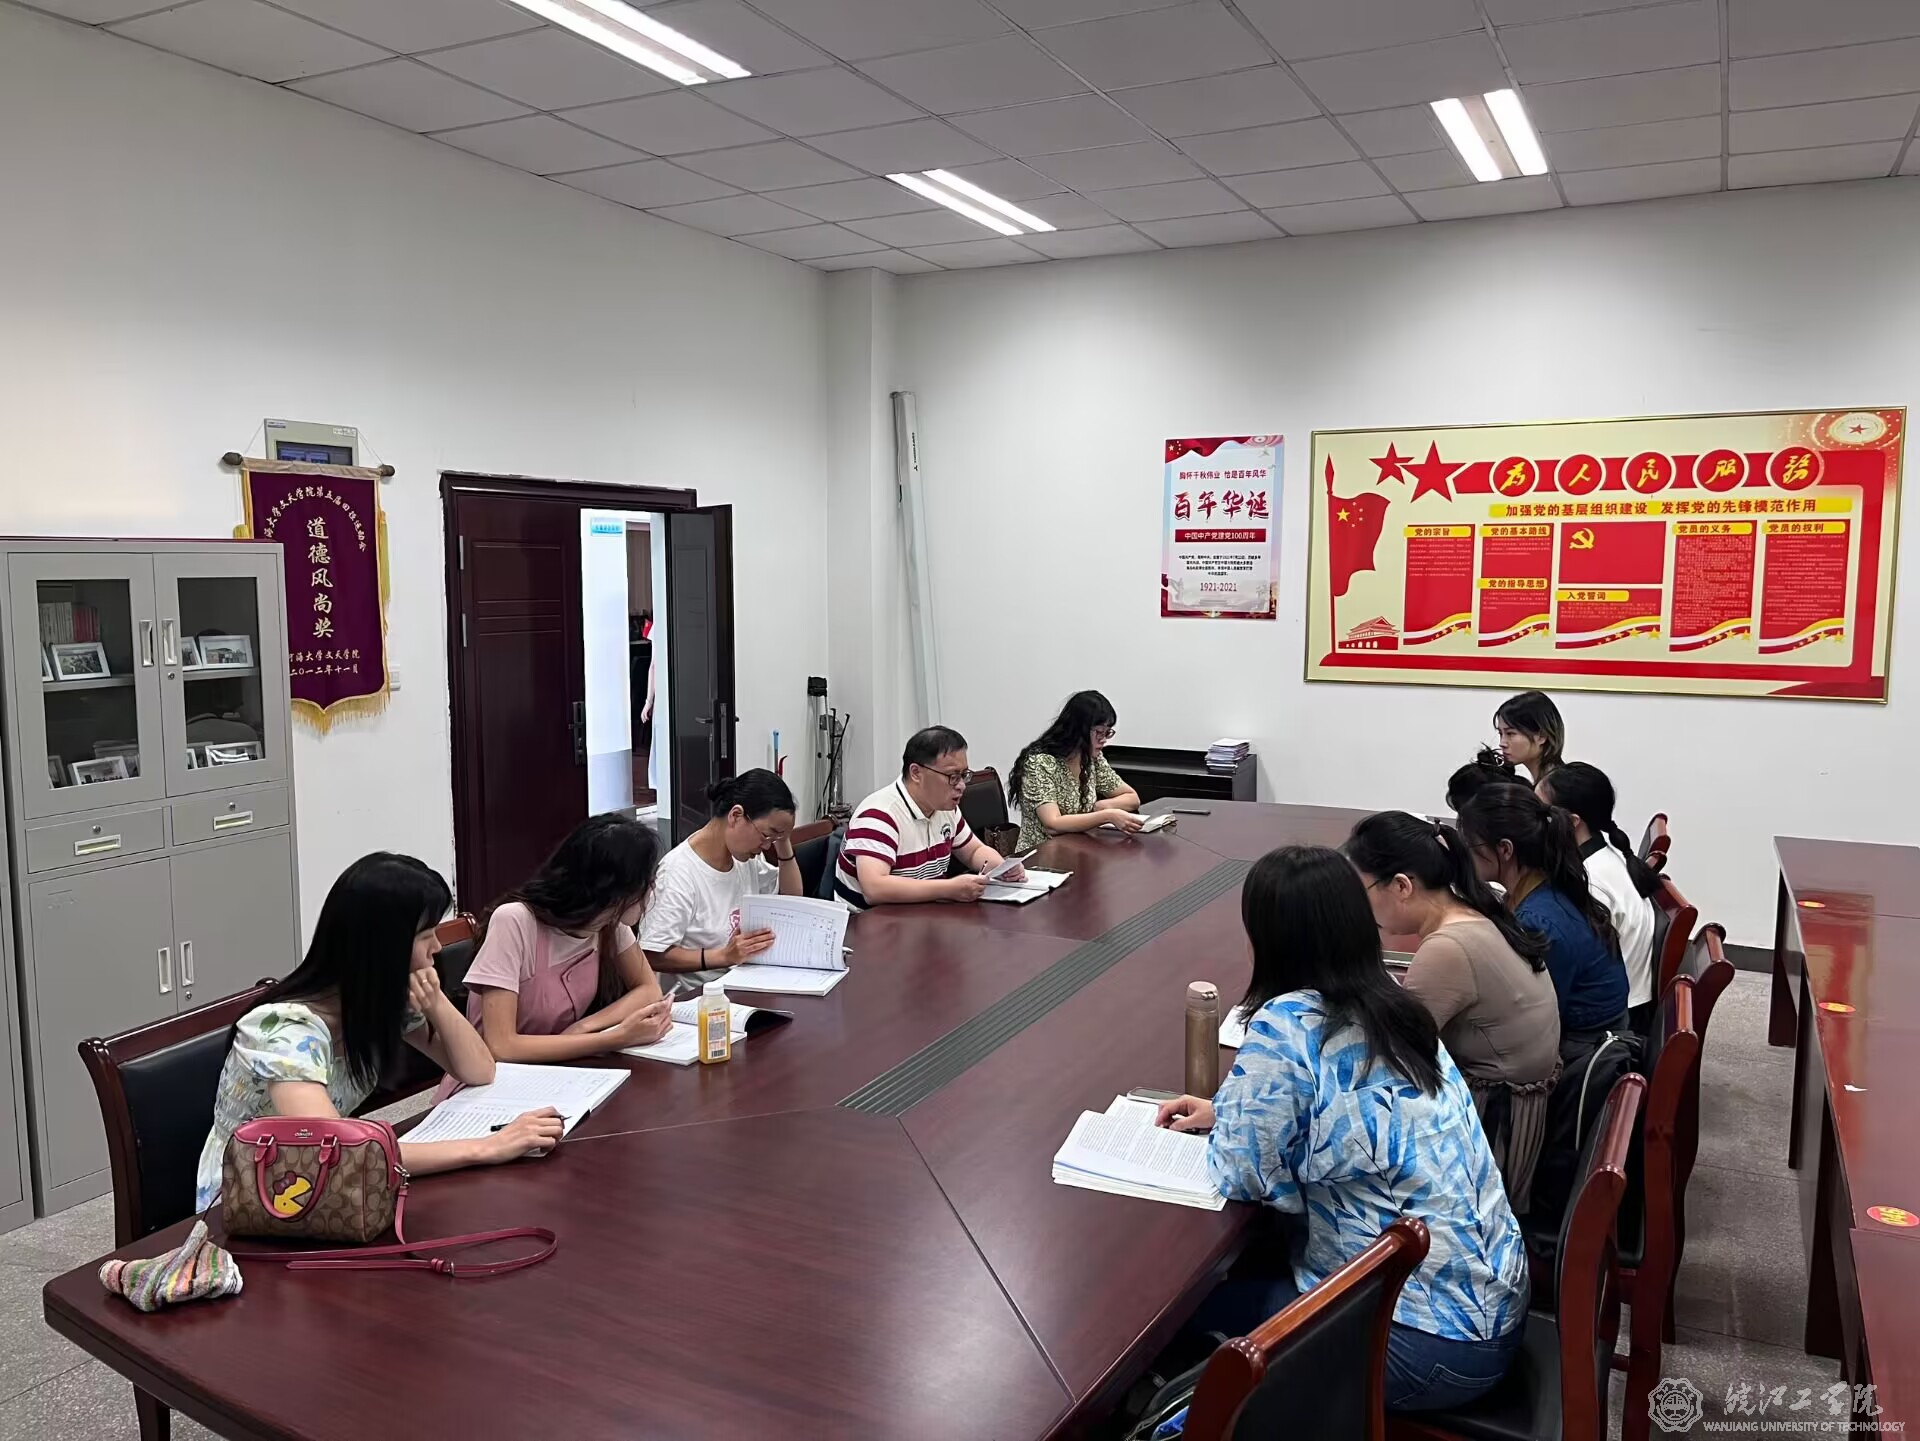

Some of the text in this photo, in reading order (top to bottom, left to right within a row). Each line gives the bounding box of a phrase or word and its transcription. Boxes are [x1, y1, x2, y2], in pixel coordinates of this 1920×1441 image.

[1224, 469, 1267, 479] 恰是百年风华
[1174, 489, 1269, 521] 百年华诞
[1505, 499, 1817, 517] 加强党的基层组织建设 发挥党的先锋模范作用
[1414, 527, 1450, 536] 党的宗旨
[1491, 526, 1547, 536] 党的基本路线
[1678, 523, 1732, 533] 党员的义务
[1769, 523, 1824, 532] 党员的权利
[306, 516, 334, 638] 道德风尚奖
[1200, 582, 1238, 592] 1921-2021
[1488, 579, 1545, 588] 党的指导思想
